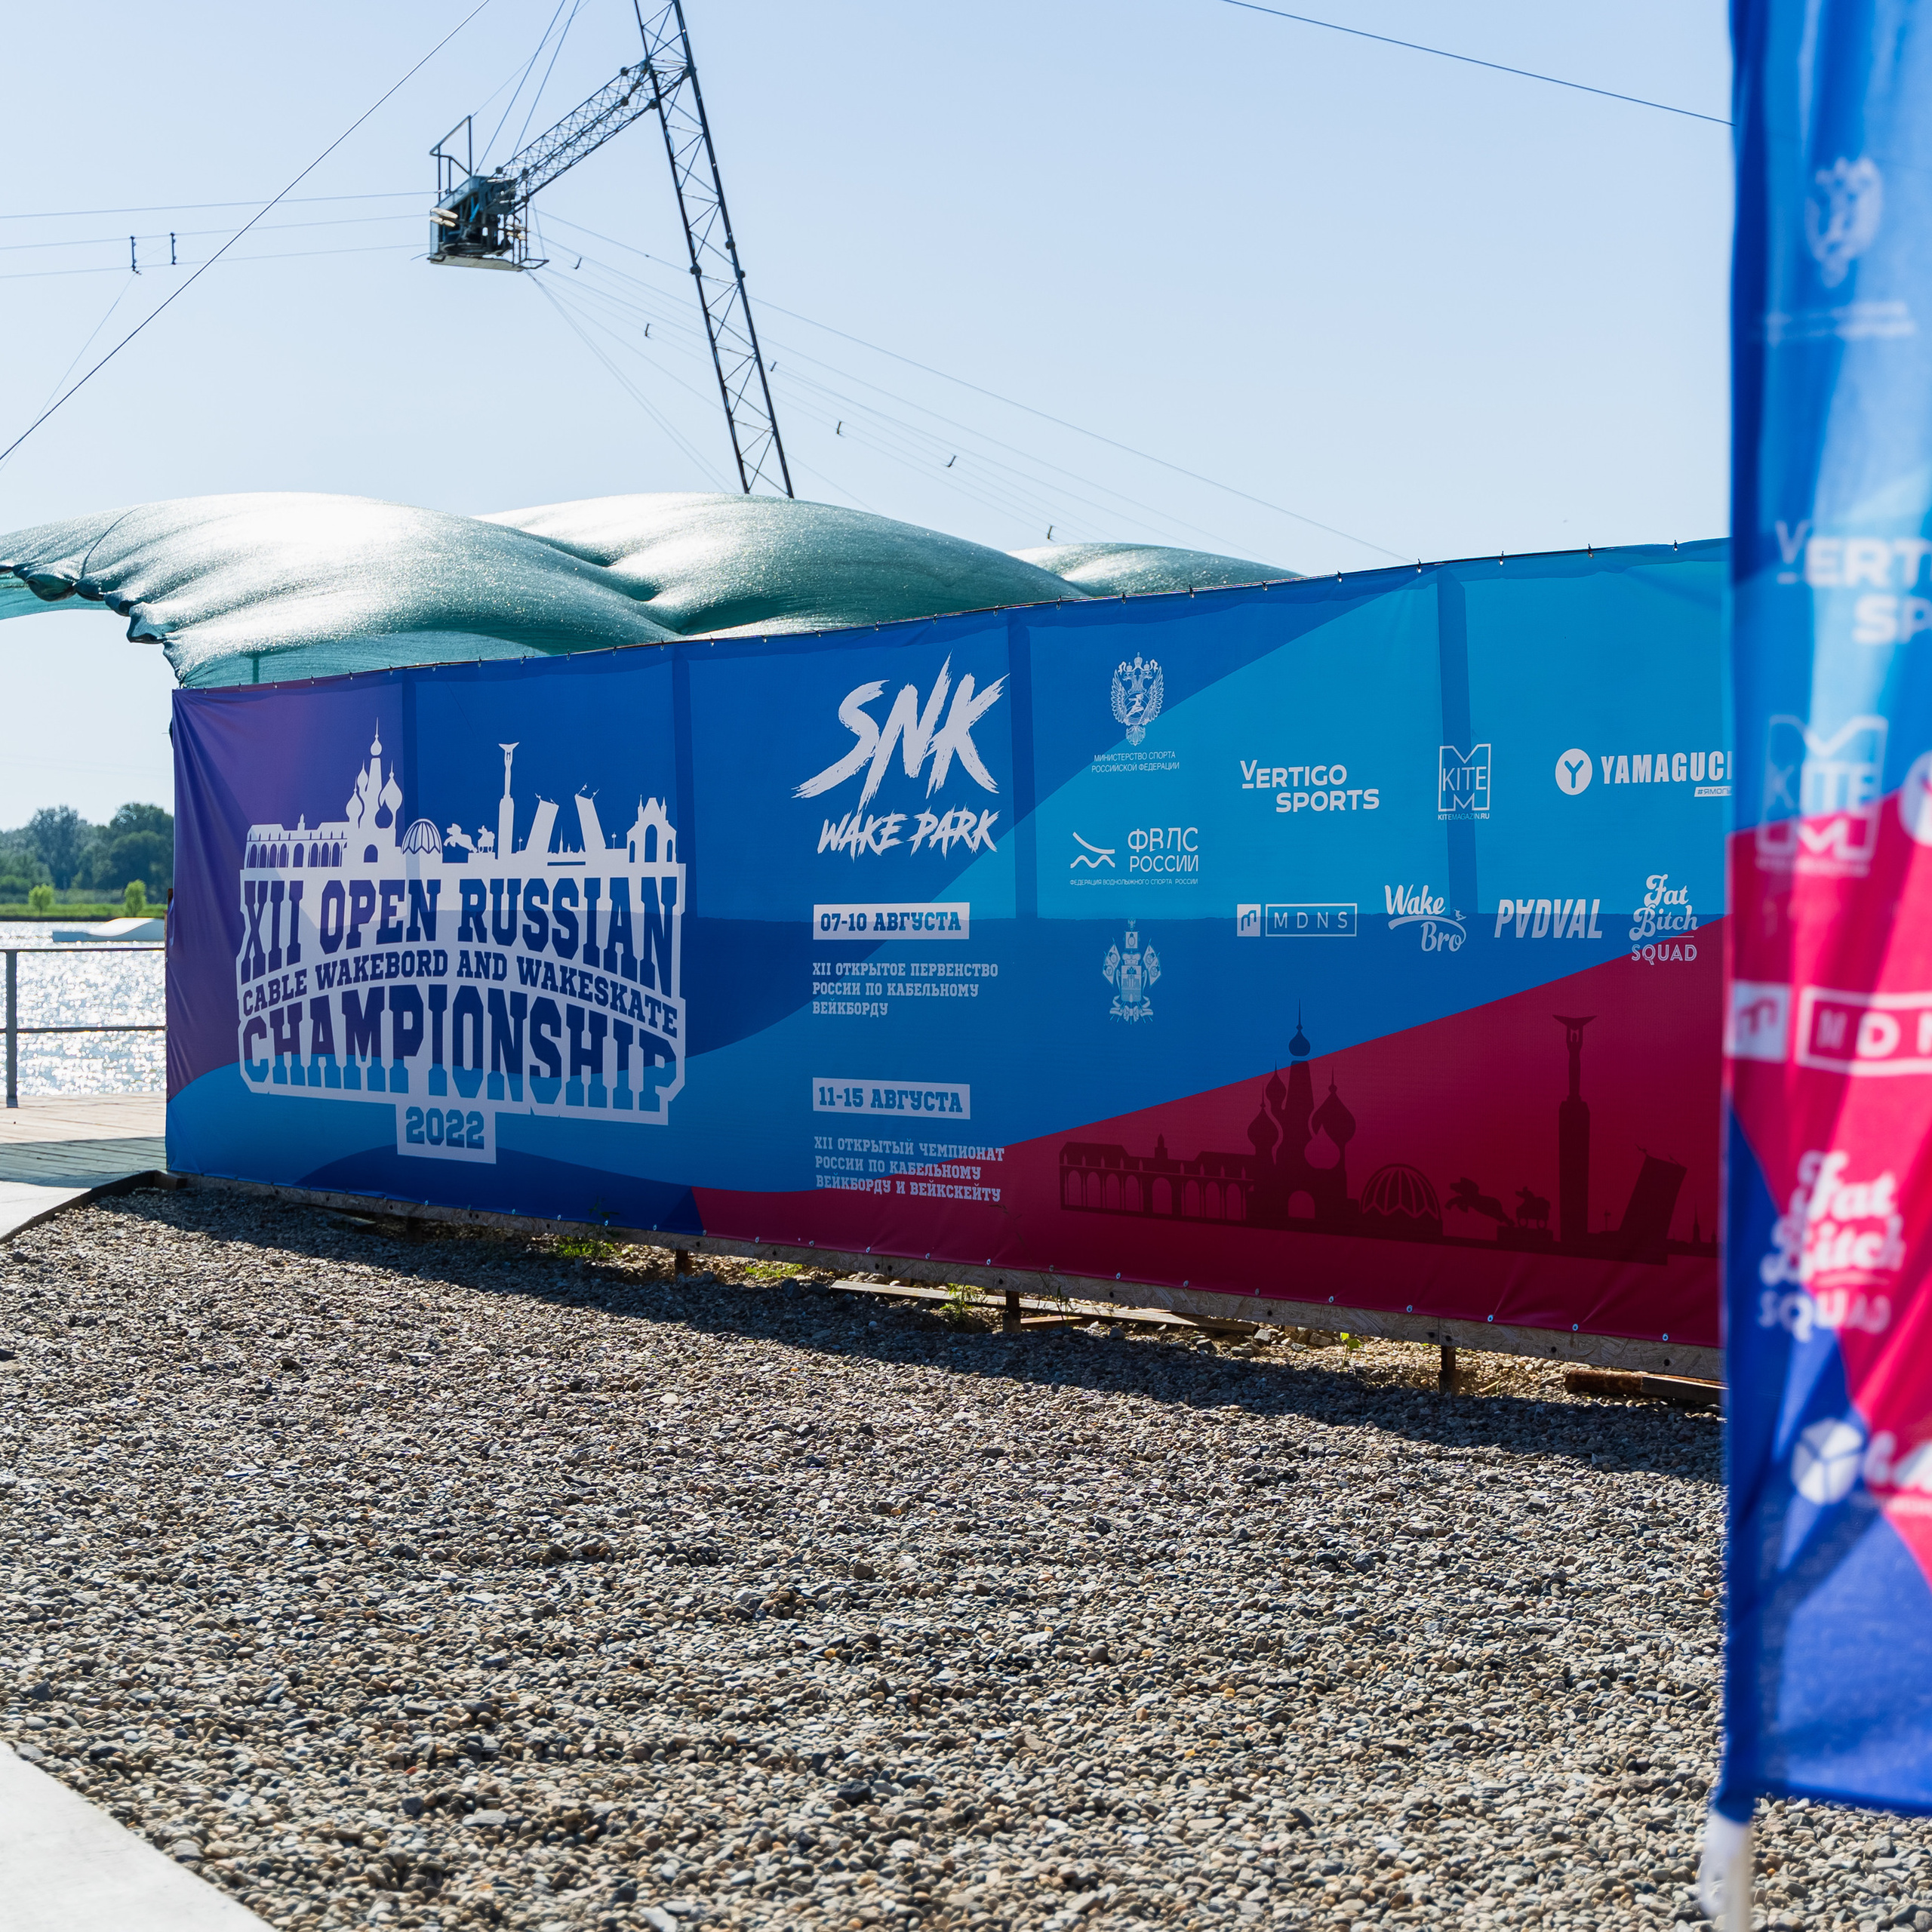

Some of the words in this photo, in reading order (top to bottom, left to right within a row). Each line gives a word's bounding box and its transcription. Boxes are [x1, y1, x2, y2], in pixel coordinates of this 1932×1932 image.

[1774, 519, 1932, 587] VERT
[791, 648, 1011, 813] SNK
[1091, 761, 1137, 773] РОССИЙСКОЙ
[1138, 761, 1180, 771] ФЕДЕРАЦИИ
[1094, 752, 1147, 762] МИНИСТЕРСТВО
[1148, 750, 1176, 760] СПОРТА
[1240, 759, 1347, 789] VERTIGO
[1442, 766, 1487, 792] KITE
[1275, 789, 1380, 813] SPORTS
[817, 809, 909, 863] WAKE
[907, 802, 1001, 860] PARK
[1128, 827, 1198, 853] ФВЛС
[1130, 854, 1198, 872] РОССИИ
[1385, 884, 1446, 915] Wake
[1644, 874, 1689, 907] Fat
[820, 913, 867, 931] 07-10
[873, 912, 961, 931] АВГУСТА
[1629, 904, 1698, 941] Bitch
[241, 880, 303, 986] XII
[320, 879, 441, 955] OPEN
[457, 876, 678, 999] RUSSIAN
[1420, 921, 1463, 952] Bro
[1632, 944, 1697, 965] SQUAD
[835, 963, 906, 976] ОТКРЫТОЕ
[910, 963, 998, 977] ПЕРВЕНСТВО
[243, 968, 307, 1017] CABLE
[315, 949, 448, 991] WAKEBORD
[457, 949, 507, 981] AND
[516, 955, 678, 1039] WAKESKATE
[812, 982, 860, 995] РОССИИ
[866, 983, 882, 995] ПО
[887, 983, 979, 997] КАБЕЛЬНОМУ
[812, 998, 888, 1017] ВЕЙКБОРДУ
[243, 983, 677, 1112] CHAMPIONSHIP
[819, 1087, 864, 1107] 11-15
[870, 1088, 963, 1112] АВГУСТА
[406, 1106, 485, 1149] 2022
[838, 1137, 914, 1155] ОТКРЫТЫЙ
[919, 1143, 1004, 1161] ЧЕМПИОНАТ
[815, 1155, 863, 1171] РОССИИ
[869, 1159, 885, 1173] ПО
[890, 1161, 981, 1180] КАБЕЛЬНОМУ
[816, 1172, 891, 1195] ВЕЙКБОРДУ
[896, 1180, 906, 1194] И
[910, 1180, 1001, 1201] ВЕЙКСКЕЙТУ
